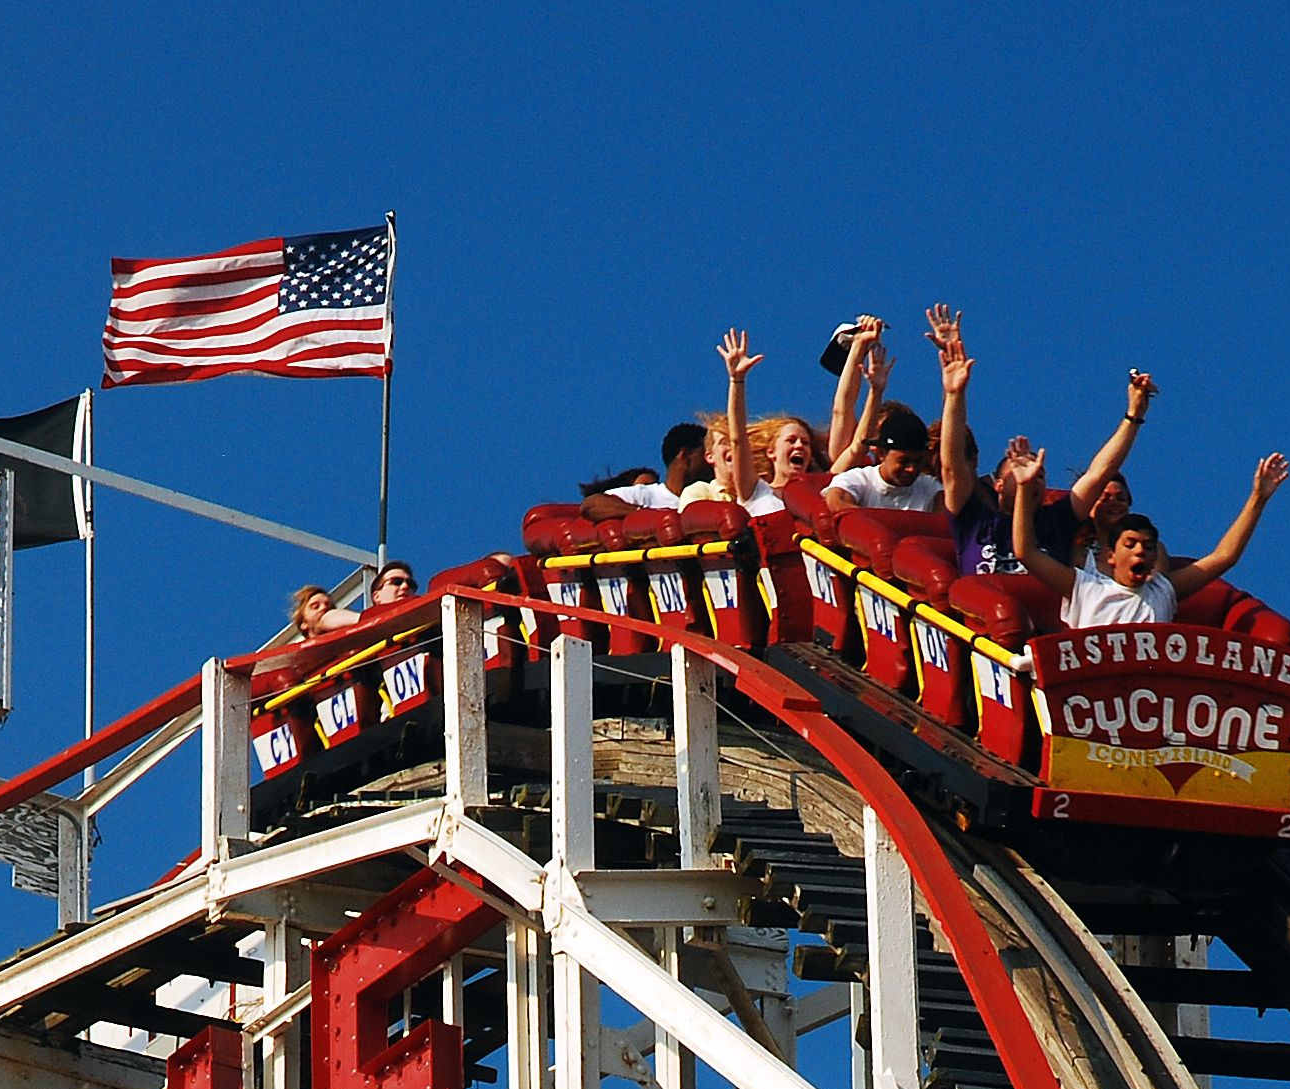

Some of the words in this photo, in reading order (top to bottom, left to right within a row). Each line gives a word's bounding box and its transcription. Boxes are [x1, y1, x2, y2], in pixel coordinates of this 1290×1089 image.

[659, 574, 686, 610] ON
[270, 723, 295, 765] CY
[331, 691, 355, 730] CL
[393, 657, 422, 701] ON
[1063, 688, 1284, 750] CYCLONE
[1095, 745, 1168, 766] CONEY
[1171, 746, 1232, 769] ISLAND
[1052, 793, 1071, 819] 2
